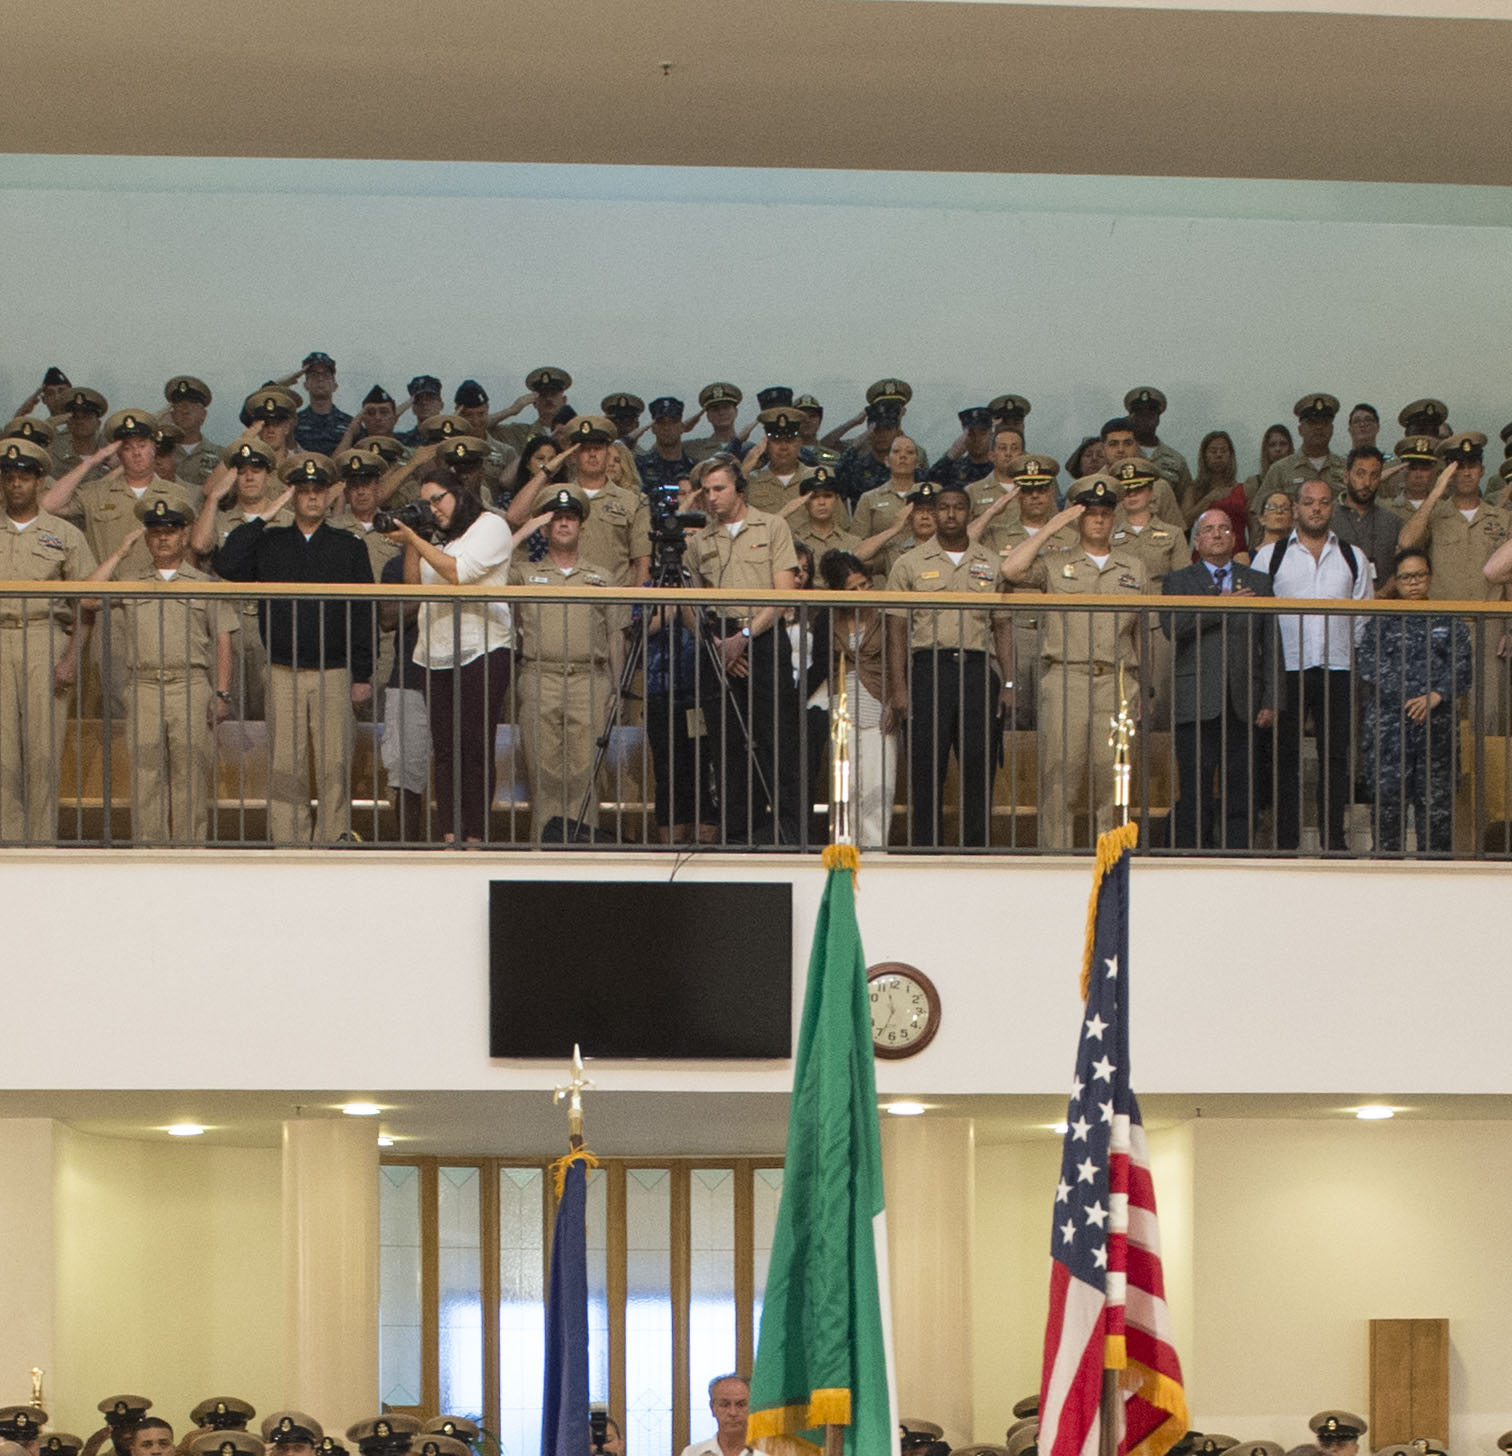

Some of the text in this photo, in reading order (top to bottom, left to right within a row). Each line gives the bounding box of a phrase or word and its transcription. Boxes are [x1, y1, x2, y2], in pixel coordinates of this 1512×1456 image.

[890, 980, 901, 990] 12
[912, 994, 920, 1004] 2
[910, 1020, 918, 1029] 4
[876, 1027, 884, 1037] 7
[888, 1031, 897, 1041] 6
[900, 1028, 908, 1038] 5
